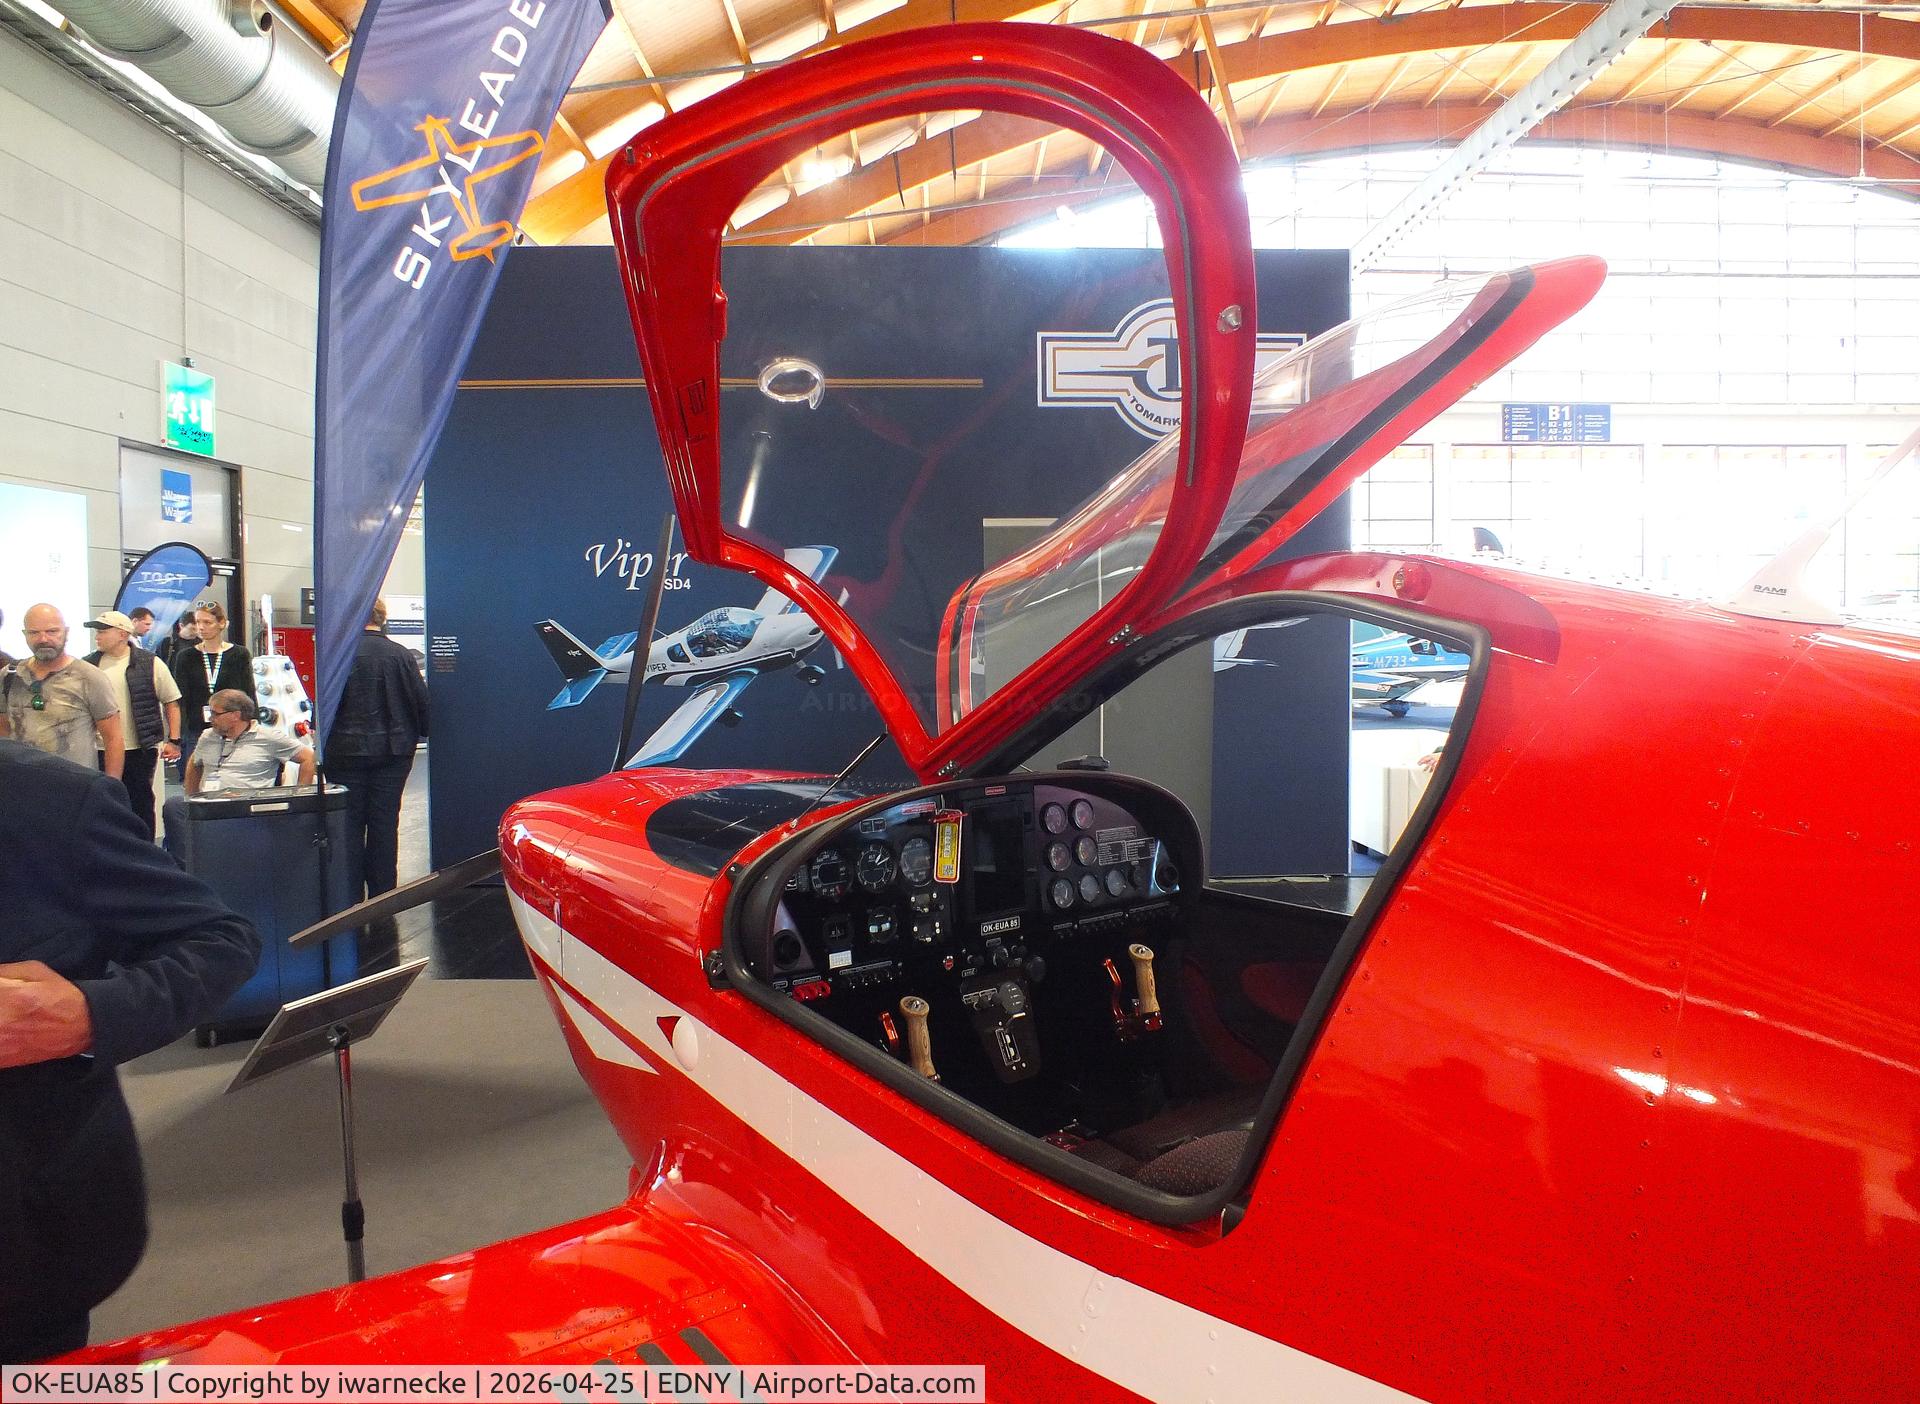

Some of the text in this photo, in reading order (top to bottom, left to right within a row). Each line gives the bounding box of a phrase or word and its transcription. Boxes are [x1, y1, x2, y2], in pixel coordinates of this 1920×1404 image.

[1548, 405, 1571, 421] B1
[585, 538, 689, 591] Vipr
[664, 578, 692, 590] SD4
[1753, 584, 1788, 594] RAMI
[982, 918, 1018, 933] OK-EUA 85
